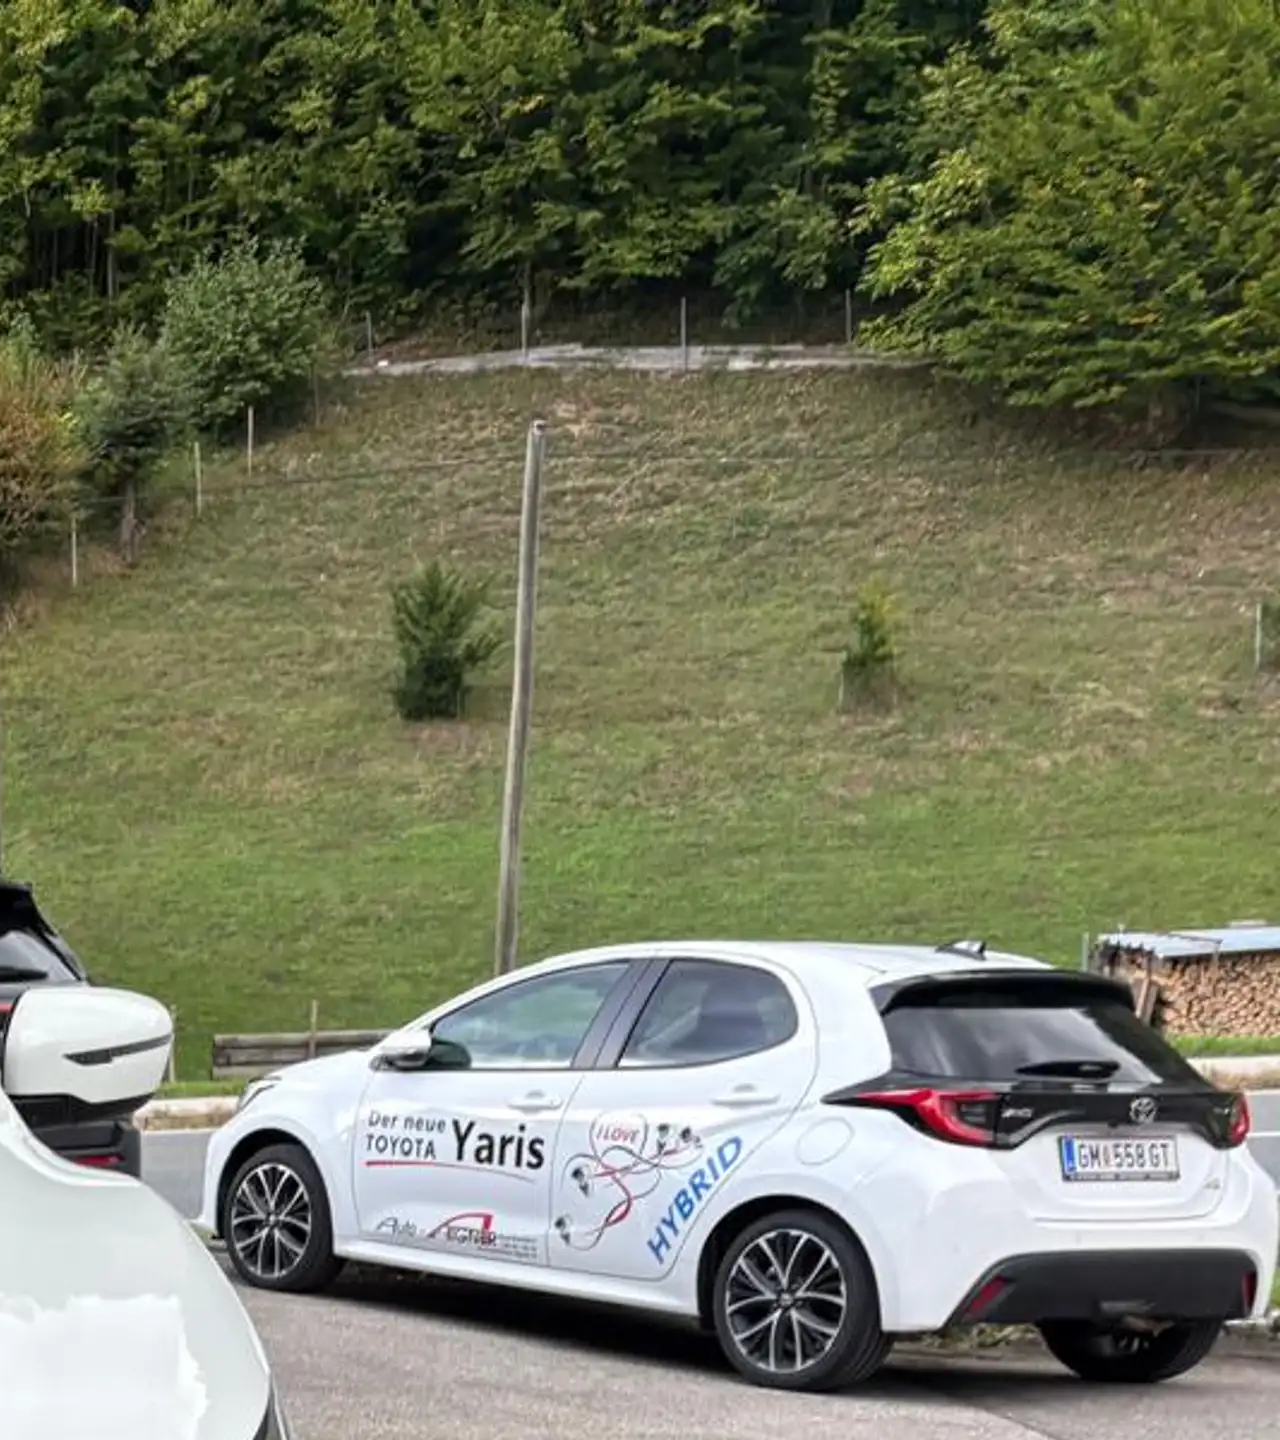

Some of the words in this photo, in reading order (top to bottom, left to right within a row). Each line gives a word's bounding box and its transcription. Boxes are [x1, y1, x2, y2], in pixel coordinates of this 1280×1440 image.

[367, 1109, 398, 1128] Der
[403, 1113, 447, 1134] neue
[366, 1132, 437, 1160] TOYOTA
[451, 1118, 545, 1170] Yaris
[647, 1135, 743, 1265] HYBRID
